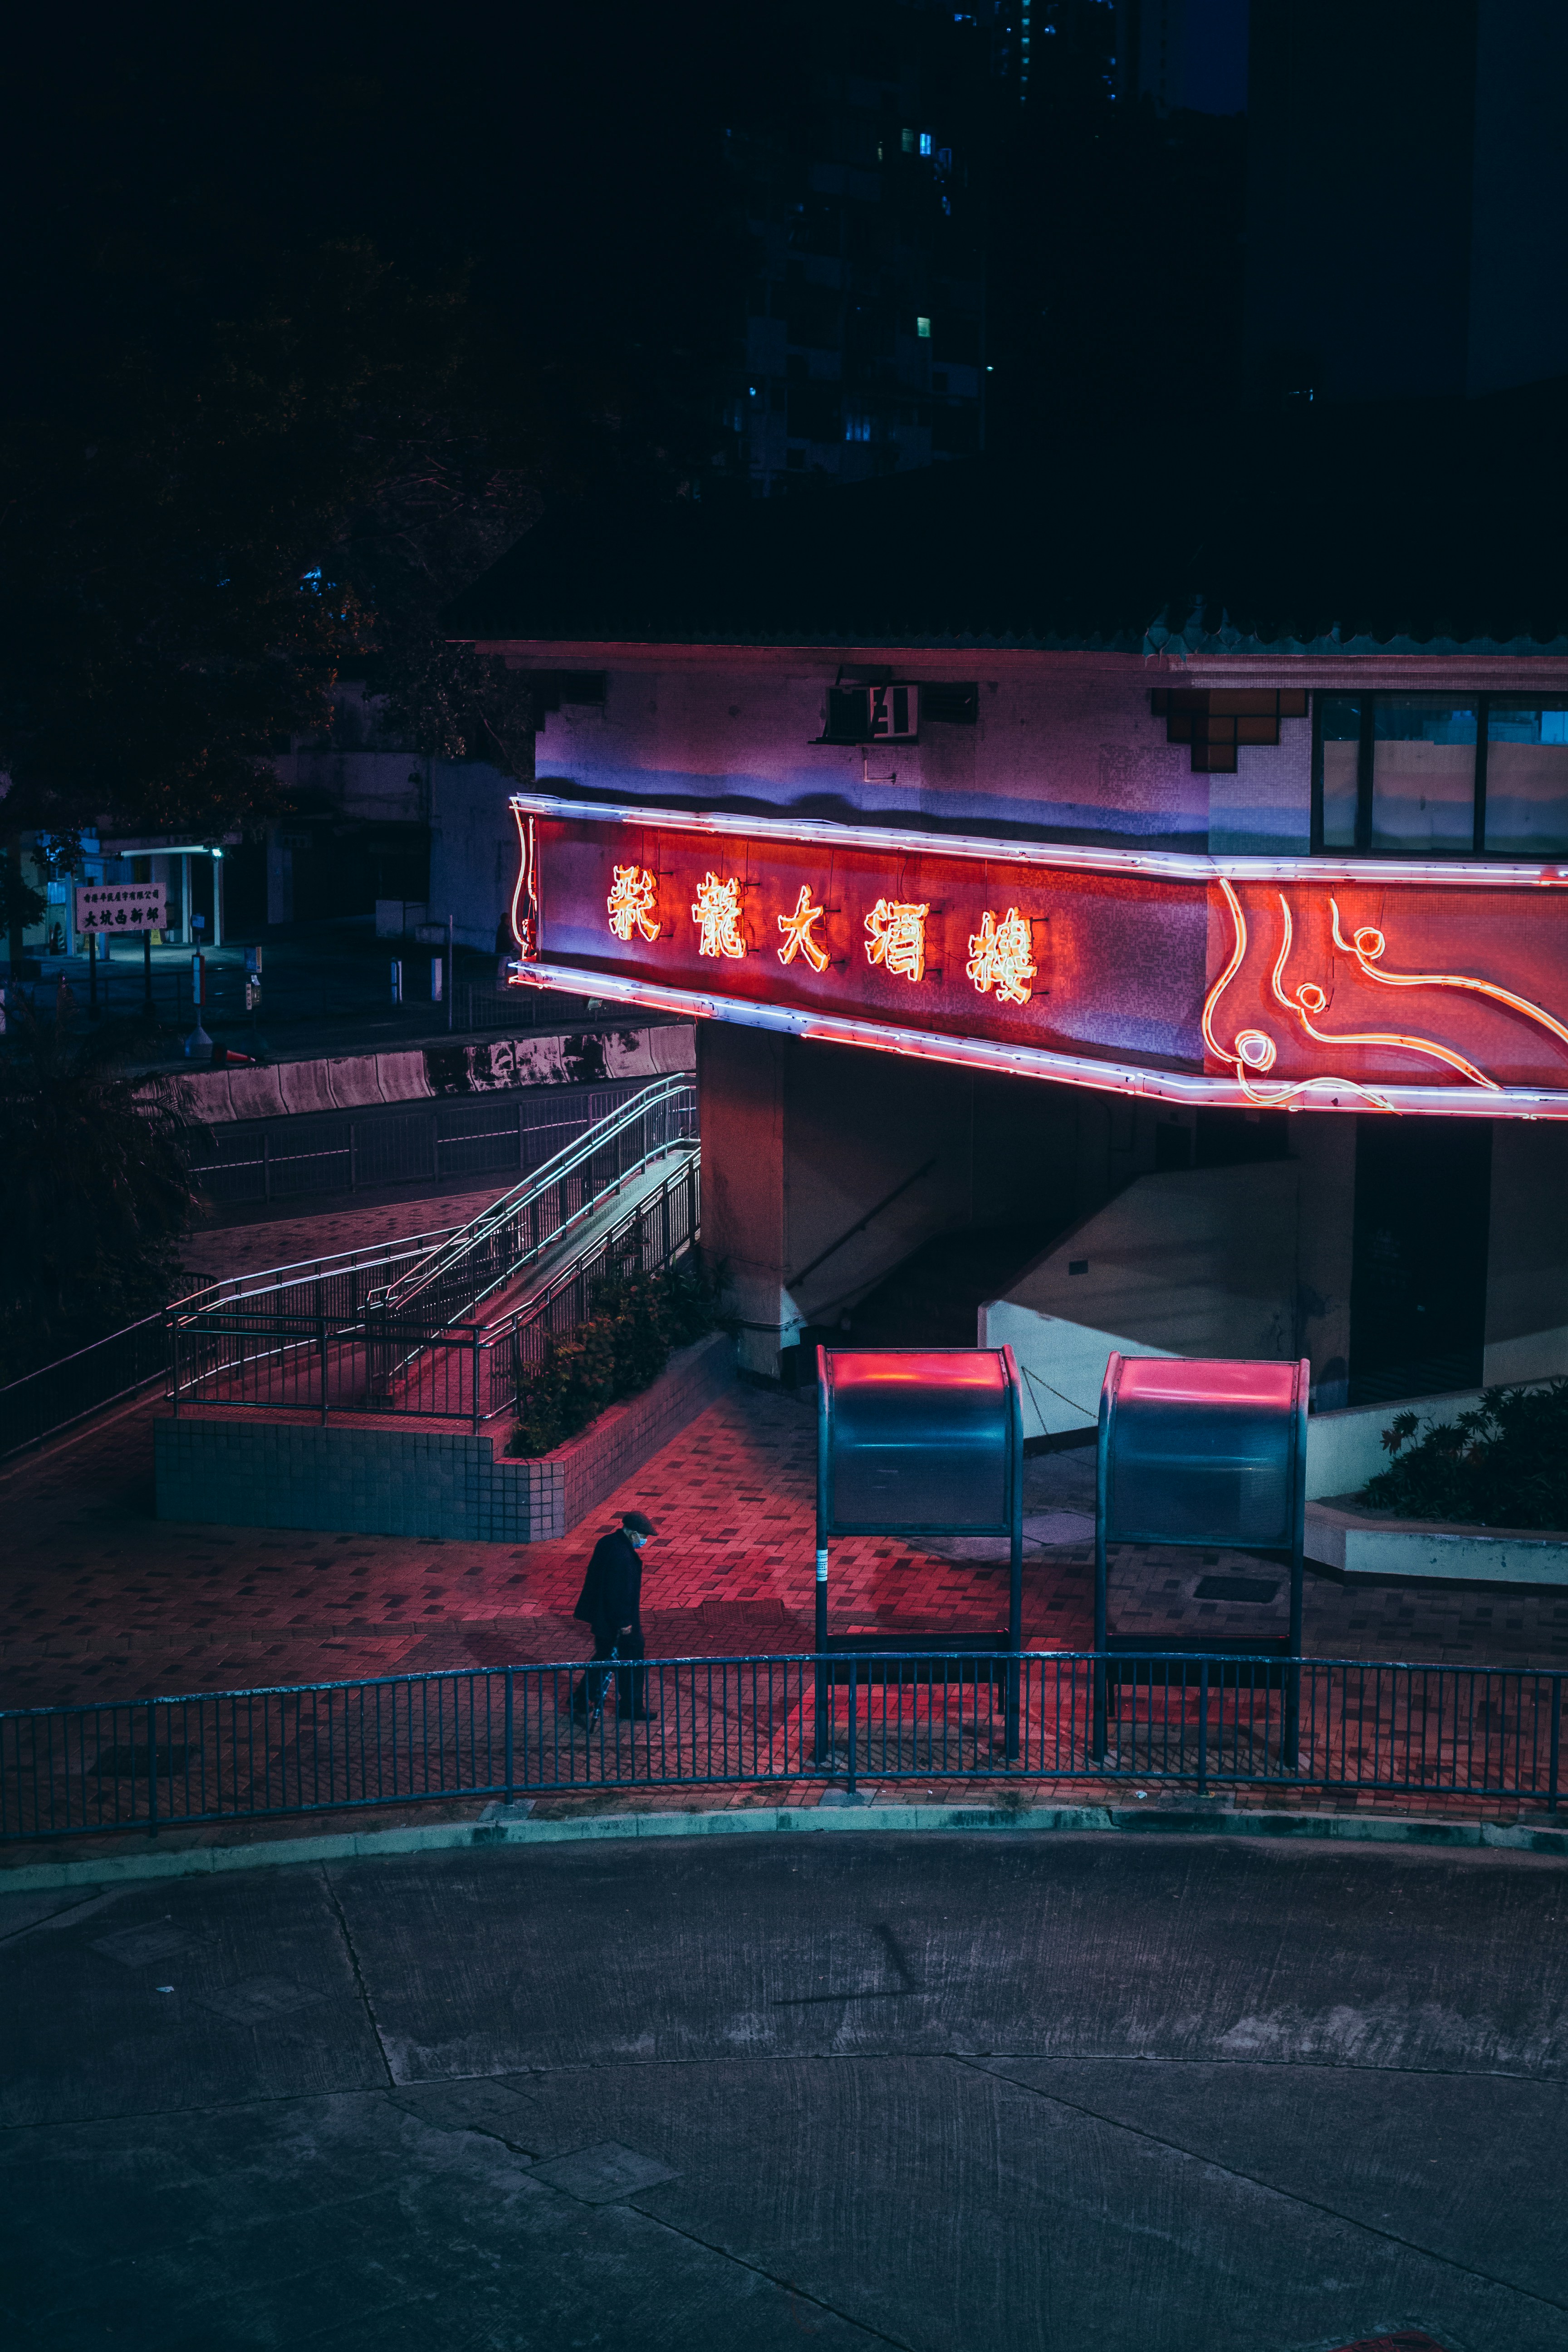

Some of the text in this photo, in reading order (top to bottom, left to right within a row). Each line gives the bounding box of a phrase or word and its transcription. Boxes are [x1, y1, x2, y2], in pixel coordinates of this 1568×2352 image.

[85, 907, 159, 927] 大坑西新邨
